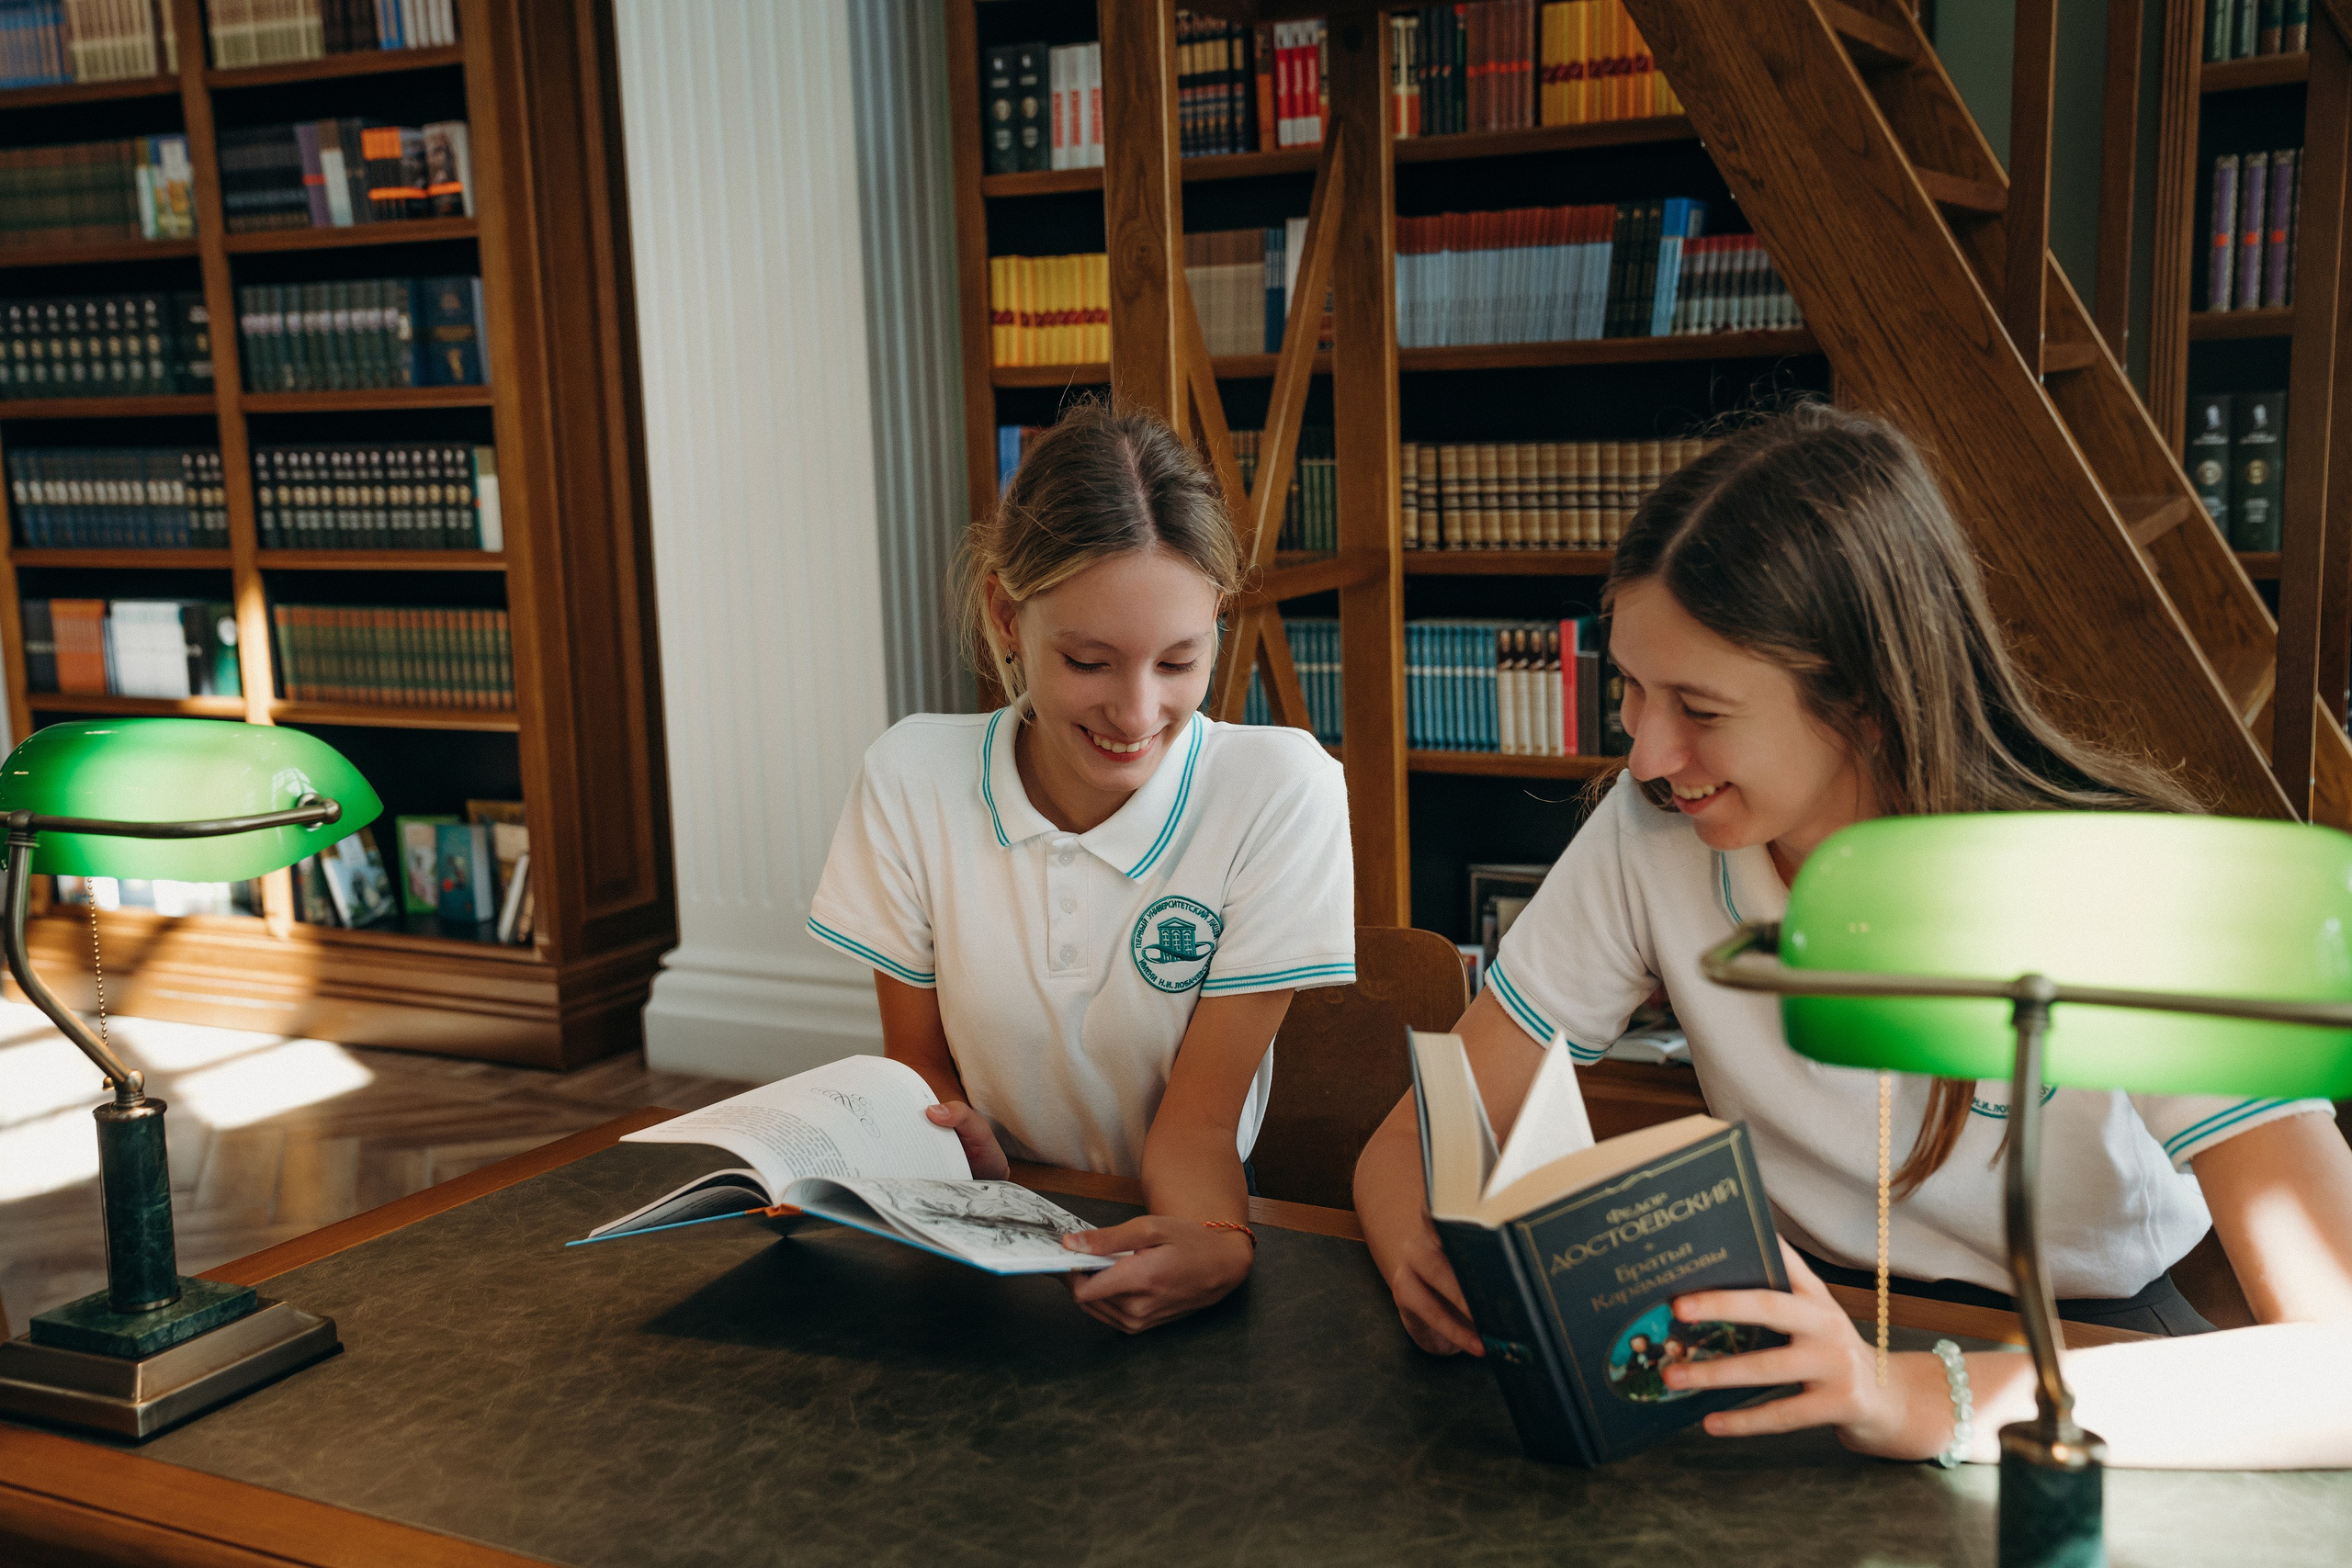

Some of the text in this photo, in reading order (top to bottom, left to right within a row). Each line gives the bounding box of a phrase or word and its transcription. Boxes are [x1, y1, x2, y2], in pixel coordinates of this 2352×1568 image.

[1147, 900, 1210, 921] УНИВЕРСИТЕТСКИЙ
[1138, 958, 1159, 983] ИМЕНИ
[1550, 1177, 1739, 1277] ДОСТОЕВСКИЙ
[1590, 1247, 1728, 1314] Карамазовы
[1614, 1242, 1694, 1284] Братья
